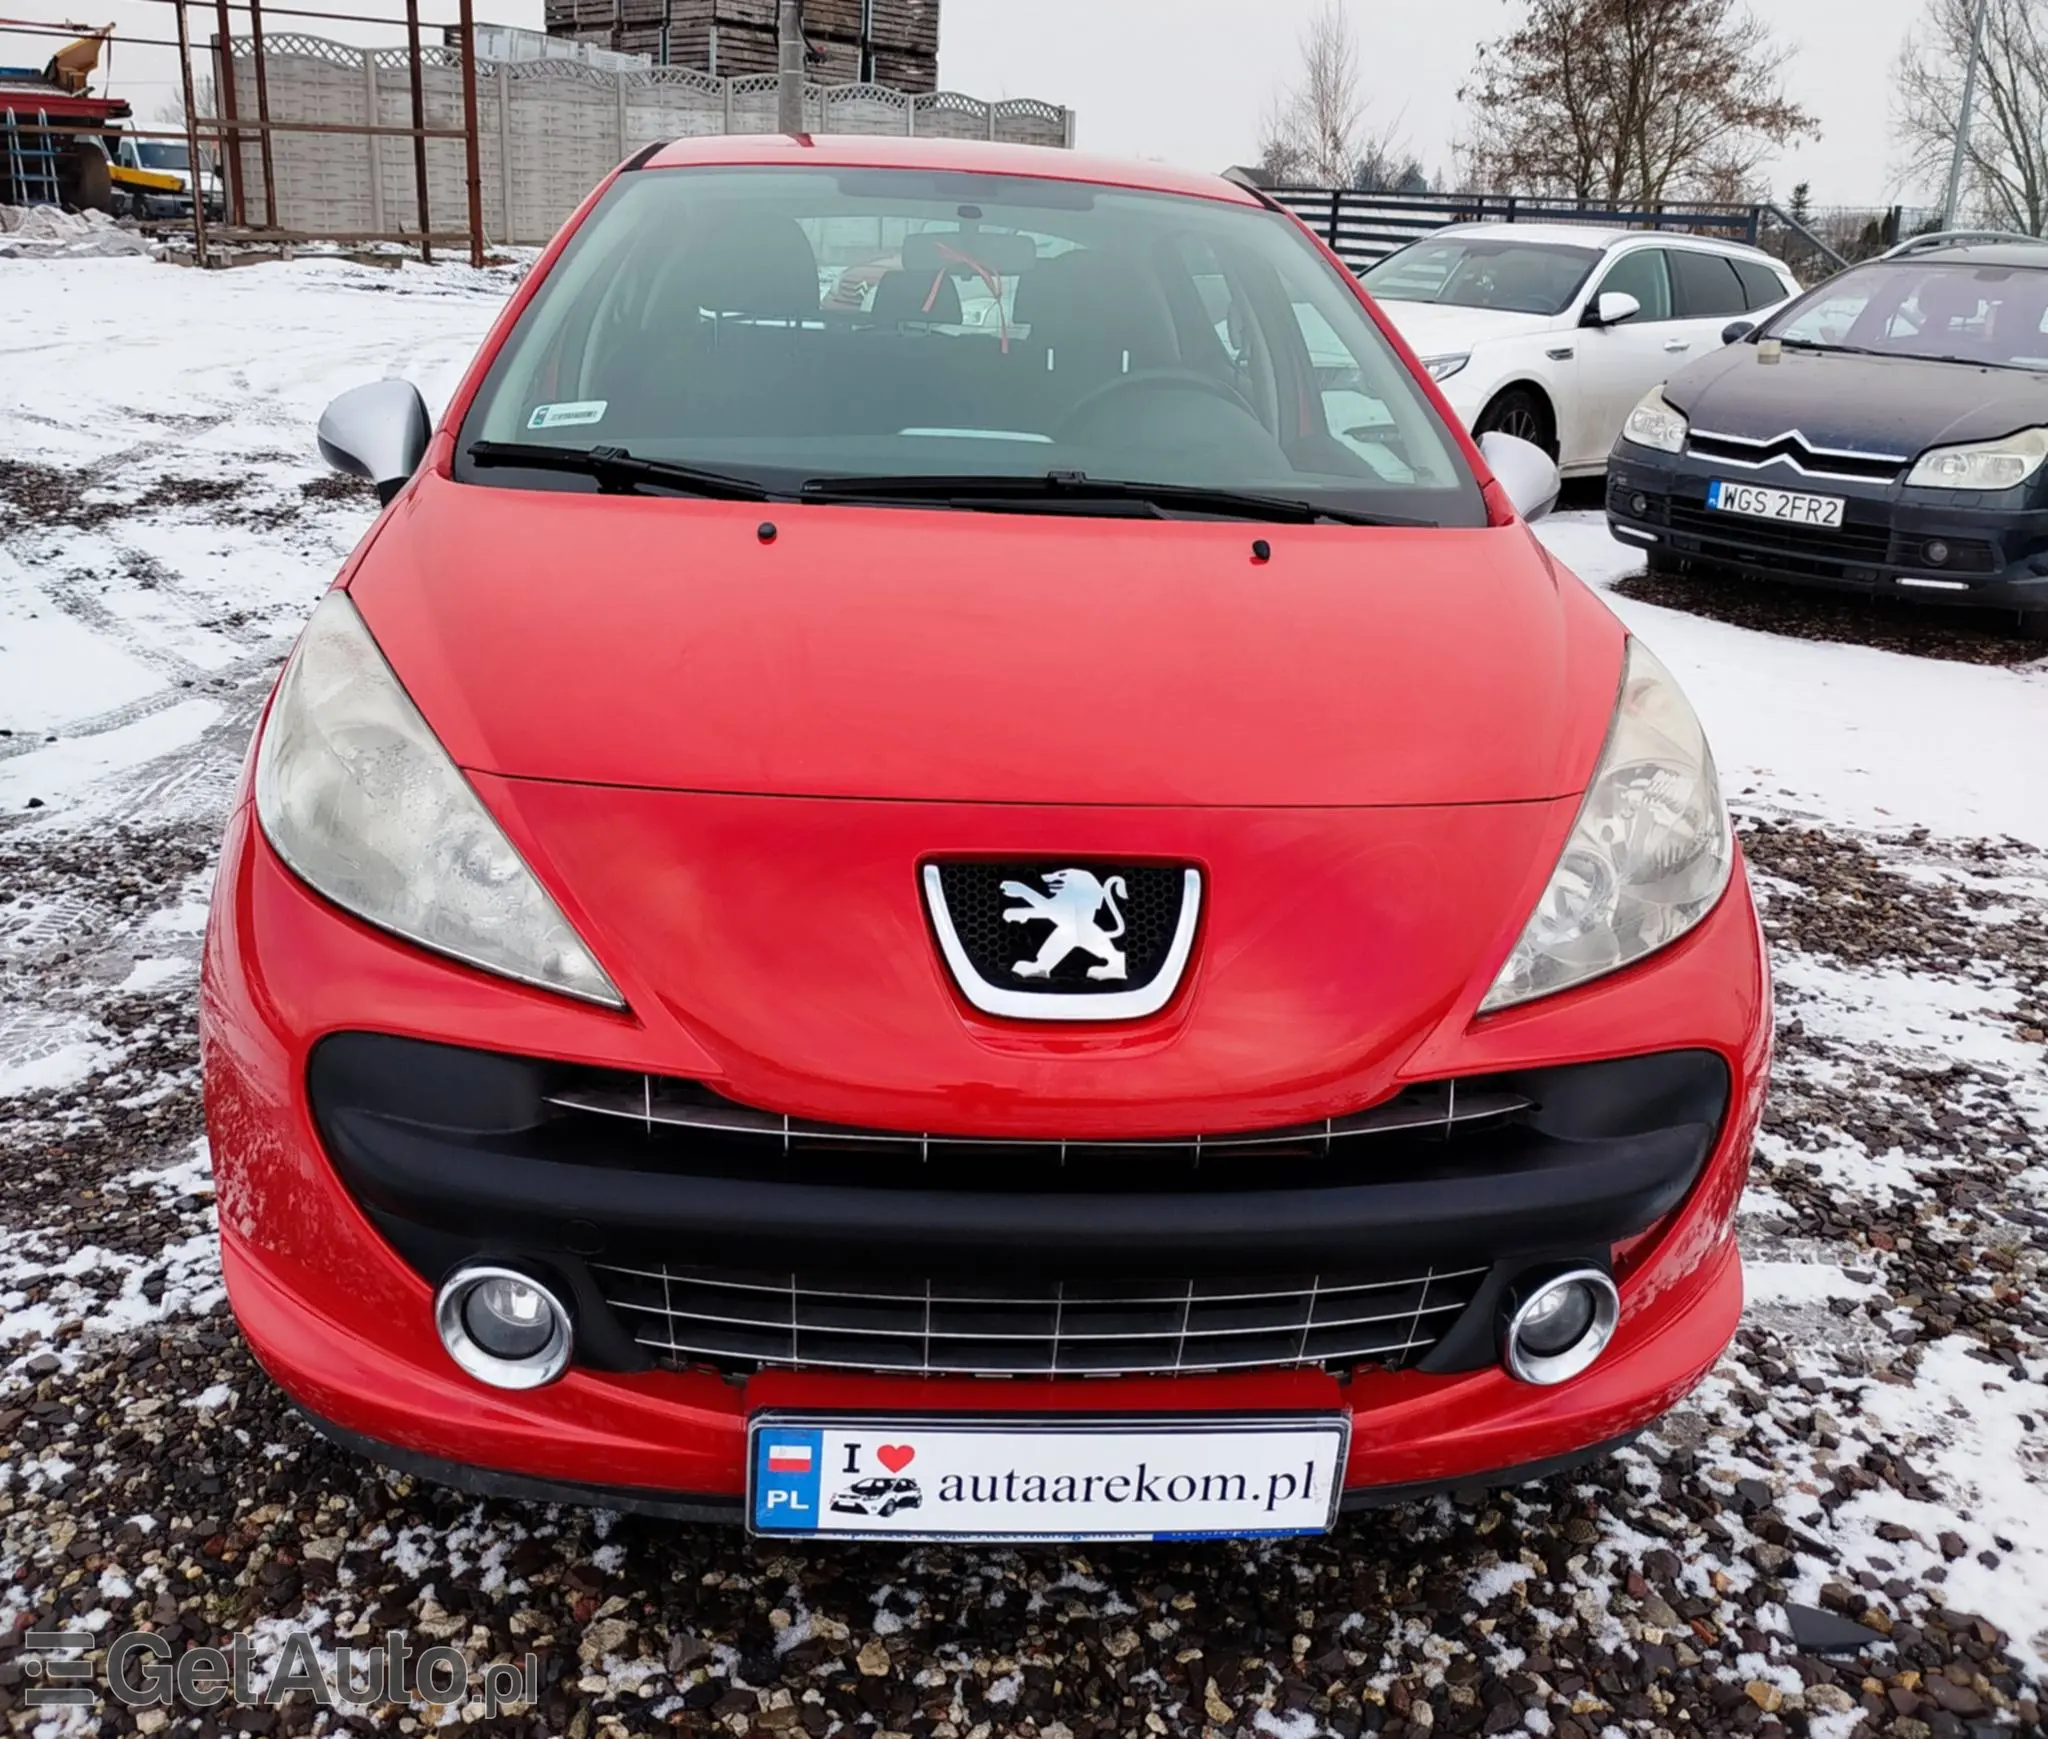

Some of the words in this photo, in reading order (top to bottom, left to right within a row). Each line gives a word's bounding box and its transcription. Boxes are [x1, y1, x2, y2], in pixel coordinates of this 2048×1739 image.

[1723, 485, 1768, 514] WGS
[1775, 494, 1838, 524] 2FR2
[842, 1443, 861, 1473] I
[767, 1490, 809, 1510] PL
[938, 1461, 1314, 1511] autaarekom.pl
